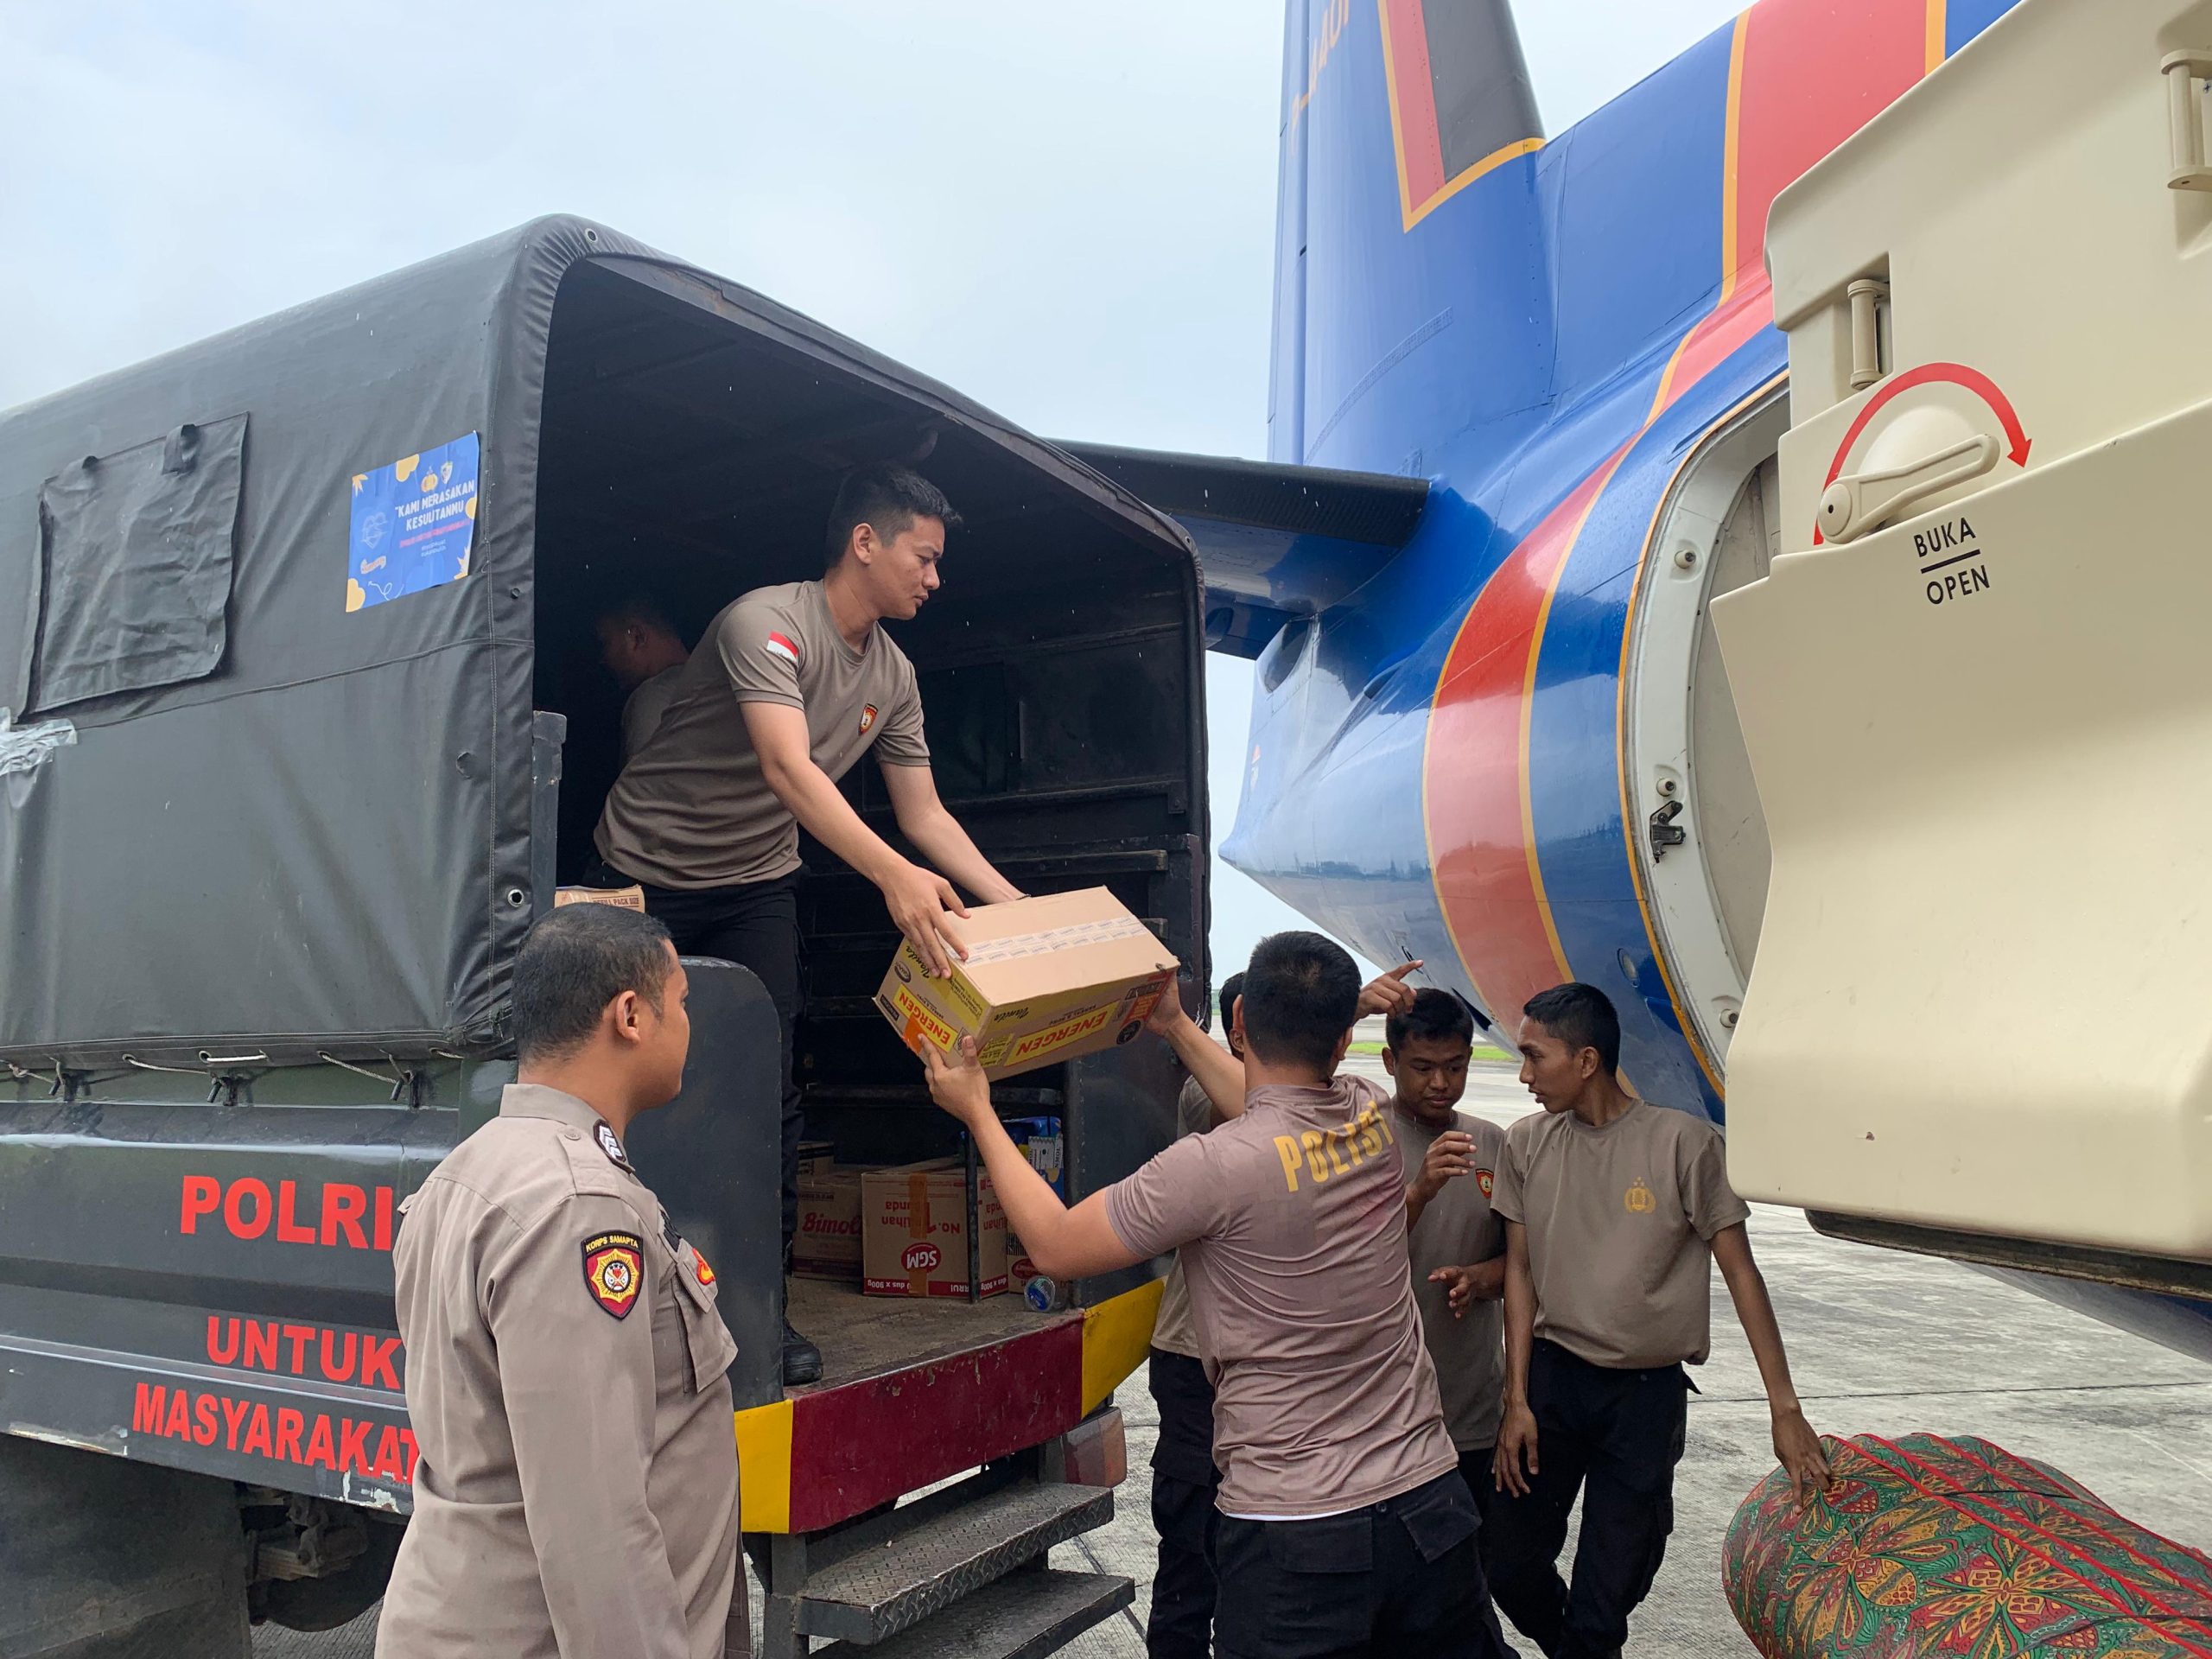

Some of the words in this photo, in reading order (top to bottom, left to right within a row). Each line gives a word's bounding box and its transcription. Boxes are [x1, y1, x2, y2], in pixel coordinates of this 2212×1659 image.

[406, 499, 464, 531] KESULITANMU
[422, 480, 475, 510] MERASAKAN
[1914, 518, 1977, 557] BUKA
[1926, 564, 1990, 605] OPEN
[899, 991, 951, 1046] ENERGEN
[1016, 1010, 1108, 1055] ENERGEN
[1273, 1101, 1394, 1192] POLISI
[181, 1174, 393, 1251] POLRI
[585, 1236, 607, 1253] KORPS
[609, 1235, 639, 1249] SAMAPTA
[906, 1249, 938, 1268] SGM
[207, 1316, 404, 1389] UNTUK
[132, 1382, 420, 1485] MASYARAKAT
